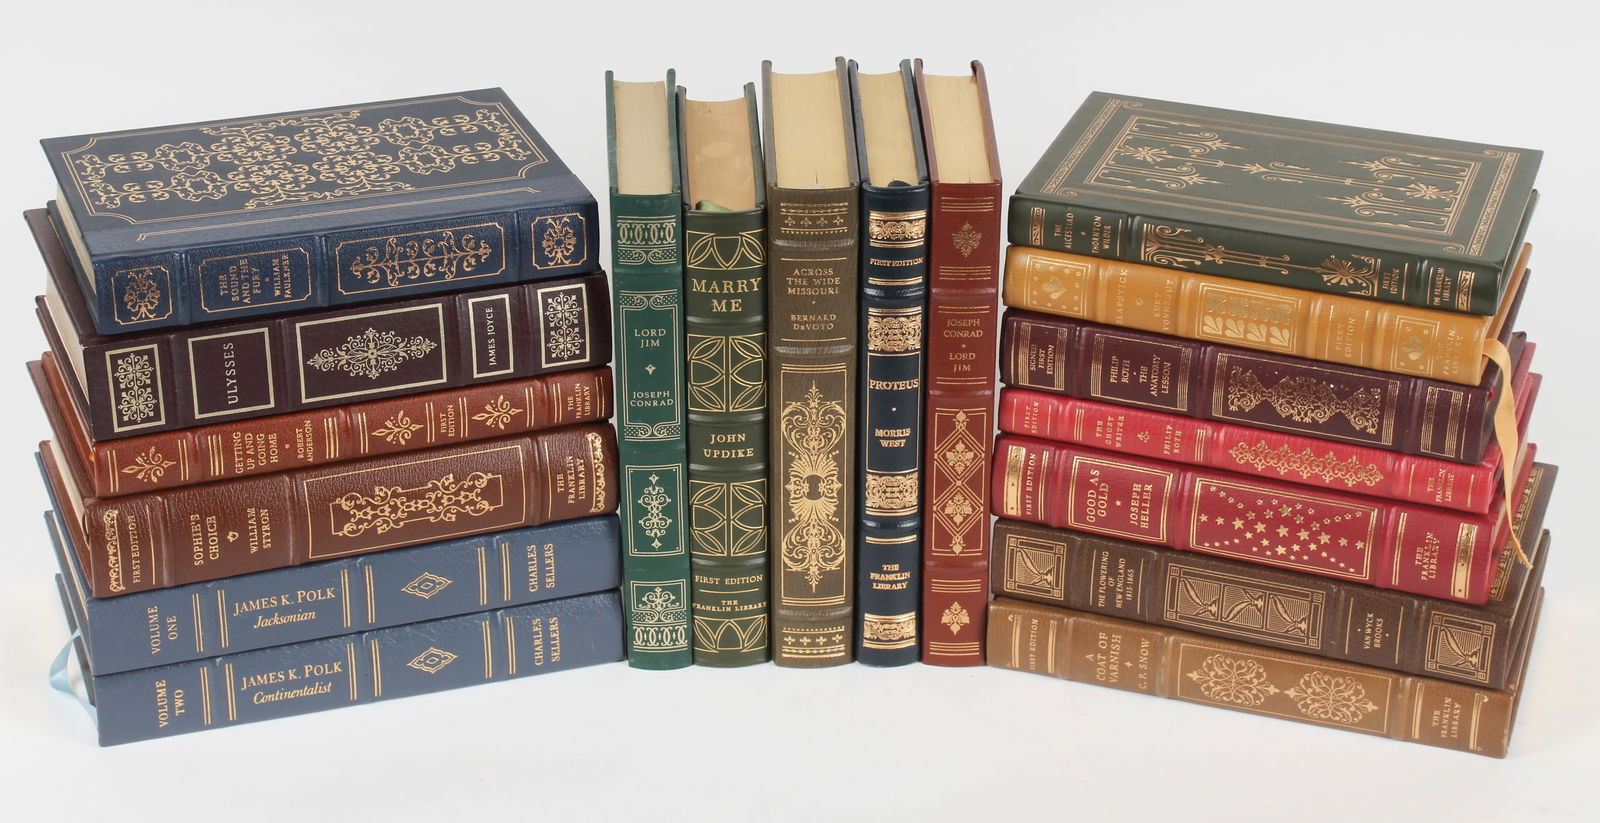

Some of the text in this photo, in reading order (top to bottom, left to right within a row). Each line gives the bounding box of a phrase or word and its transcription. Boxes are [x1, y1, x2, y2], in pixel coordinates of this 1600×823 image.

[1064, 212, 1074, 248] ALCESTIAD
[1092, 216, 1101, 254] THORNTON
[1103, 226, 1112, 250] WILDER
[272, 258, 281, 297] WILLIAM
[282, 254, 292, 298] FAULKNER
[792, 268, 834, 276] ACROSS
[870, 257, 924, 266] FIRST EDITION
[219, 274, 228, 296] THE
[230, 266, 239, 301] SOUND
[240, 259, 250, 303] AND THE
[252, 267, 262, 294] FURY
[692, 278, 762, 294] MARRY
[786, 277, 841, 286] THE WIDE
[787, 286, 839, 295] MISSOURI
[712, 299, 742, 312] ME
[790, 314, 836, 322] BERNARD
[486, 306, 497, 366] JAMES JOYCE
[634, 328, 666, 337] LORD
[944, 330, 984, 338] CONRAD
[948, 318, 980, 327] JOSEPH
[640, 339, 660, 348] JIM
[949, 352, 976, 360] LORD
[224, 342, 238, 404] ULYSSES
[953, 364, 971, 372] JIM
[1110, 356, 1119, 383] PHILIP
[1122, 360, 1130, 383] ROTH
[1140, 366, 1148, 382] THE
[1150, 354, 1161, 396] ANATOMY
[1162, 362, 1171, 394] LESSON
[633, 390, 670, 398] JOSEPH
[869, 379, 918, 390] PROTEUS
[296, 427, 304, 459] ROBERT
[304, 420, 313, 462] ANDERSON
[710, 434, 746, 444] JOHN
[874, 428, 911, 438] MORRIS
[880, 439, 906, 448] WEST
[1106, 416, 1114, 445] GHOST
[1116, 416, 1125, 448] WRITER
[1164, 425, 1173, 454] PHILIP
[232, 432, 243, 474] GETTING
[244, 433, 254, 470] UP AND
[257, 433, 266, 466] GOING
[269, 433, 278, 463] HOME
[704, 448, 754, 459] UPDIKE
[578, 458, 586, 500] LIBRARY
[1026, 453, 1036, 490] EDITION
[1087, 470, 1100, 522] GOOD AS
[1098, 483, 1109, 517] GOLD
[1130, 483, 1142, 525] JOSEPH
[1140, 484, 1152, 528] HELLER
[190, 514, 203, 565] SOPHIE'S
[207, 516, 219, 560] CHOICE
[247, 508, 258, 554] WILLIAM
[261, 509, 271, 549] STYRON
[128, 515, 140, 583] FIRST EDITION
[527, 544, 538, 592] CHARLES
[544, 544, 555, 588] SELLERS
[695, 574, 764, 584] FIRST EDITION
[870, 572, 910, 580] FRANKLIN
[1098, 552, 1110, 592] FLOWERING
[1108, 576, 1114, 586] OF
[1116, 558, 1126, 592] ENGLAND
[233, 588, 336, 616] JAMES K. POLK
[734, 602, 768, 611] LIBRARY
[148, 606, 160, 654] VOLUME
[168, 616, 178, 640] ONE
[254, 610, 316, 629] Jacksonian
[1030, 618, 1038, 652] EDITION
[1364, 613, 1374, 634] WYCK
[1374, 618, 1383, 648] BROOKS
[533, 618, 542, 666] CHARLES
[550, 617, 560, 662] SELLERS
[1140, 638, 1150, 670] SNOW
[1097, 633, 1108, 681] COAT OF
[1109, 634, 1122, 683] VARNISH
[240, 661, 342, 690] JAMES K. POLK
[156, 680, 169, 728] VOLUME
[176, 689, 184, 716] TWO
[253, 682, 332, 704] Continentalist
[1441, 697, 1452, 738] FRANKLIN
[1452, 702, 1460, 737] LIBRARY
